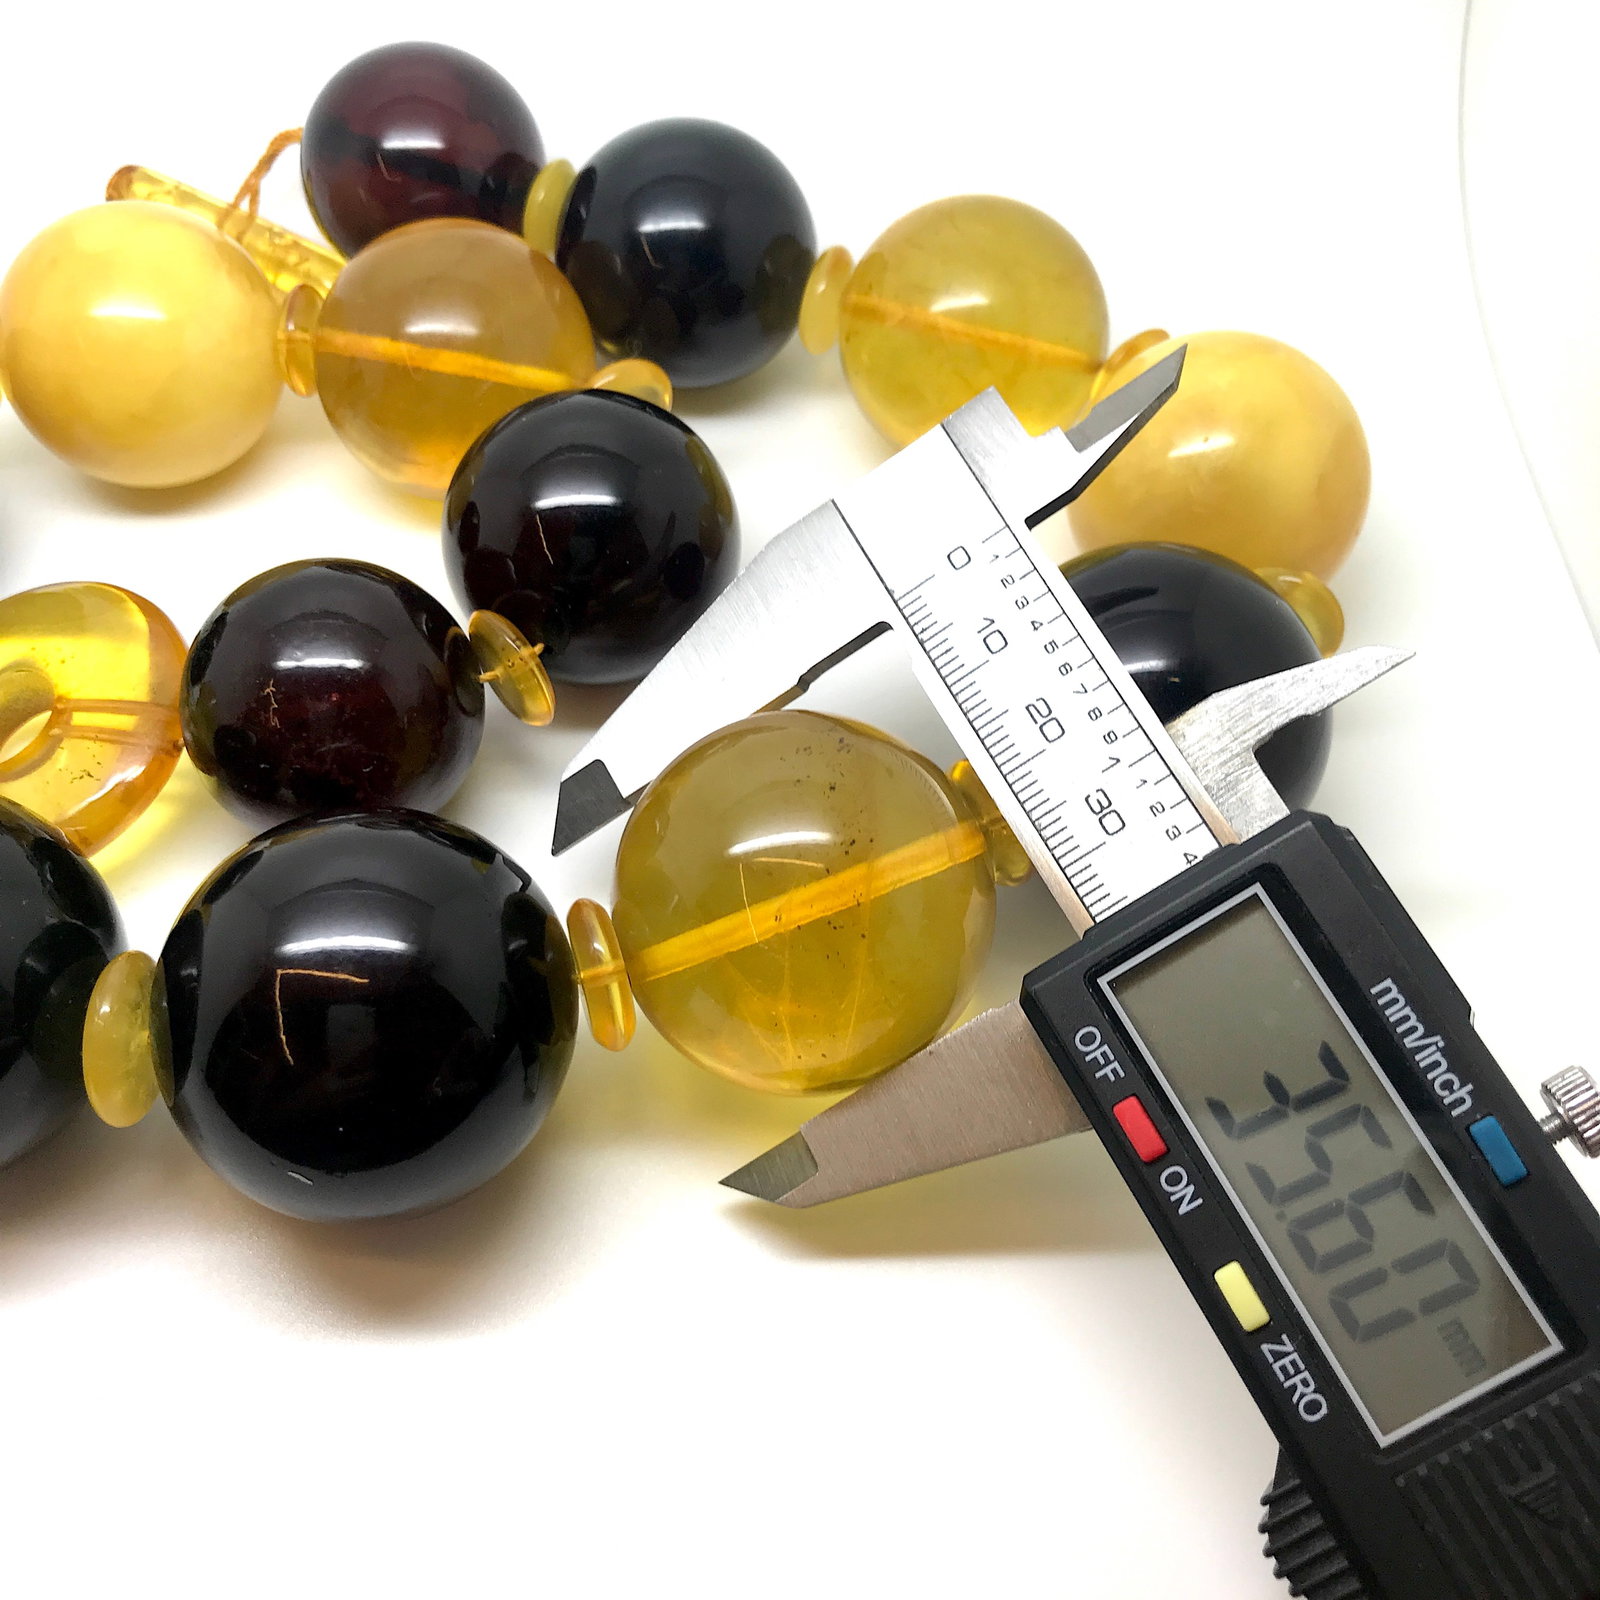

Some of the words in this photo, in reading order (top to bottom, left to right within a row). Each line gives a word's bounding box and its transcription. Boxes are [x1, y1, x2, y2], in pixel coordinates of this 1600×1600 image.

[947, 546, 971, 570] 0
[989, 554, 999, 563] 1
[1000, 574, 1015, 589] 2
[1015, 595, 1029, 610] 3
[1031, 619, 1044, 632] 4
[978, 617, 1008, 654] 10
[1044, 640, 1059, 654] 5
[1059, 662, 1073, 676] 6
[1073, 683, 1088, 696] 7
[1025, 697, 1065, 743] 20
[1088, 707, 1102, 721] 8
[1103, 730, 1118, 744] 9
[1101, 756, 1121, 773] 1
[1136, 778, 1147, 789] 1
[1085, 788, 1126, 836] 30
[1150, 801, 1165, 817] 2
[1165, 825, 1181, 840] 3
[1183, 851, 1199, 865] 4
[1074, 1024, 1126, 1084] OFF
[1369, 977, 1477, 1117] mm/inch
[1158, 1165, 1203, 1216] ON
[1260, 1334, 1328, 1423] ZERO
